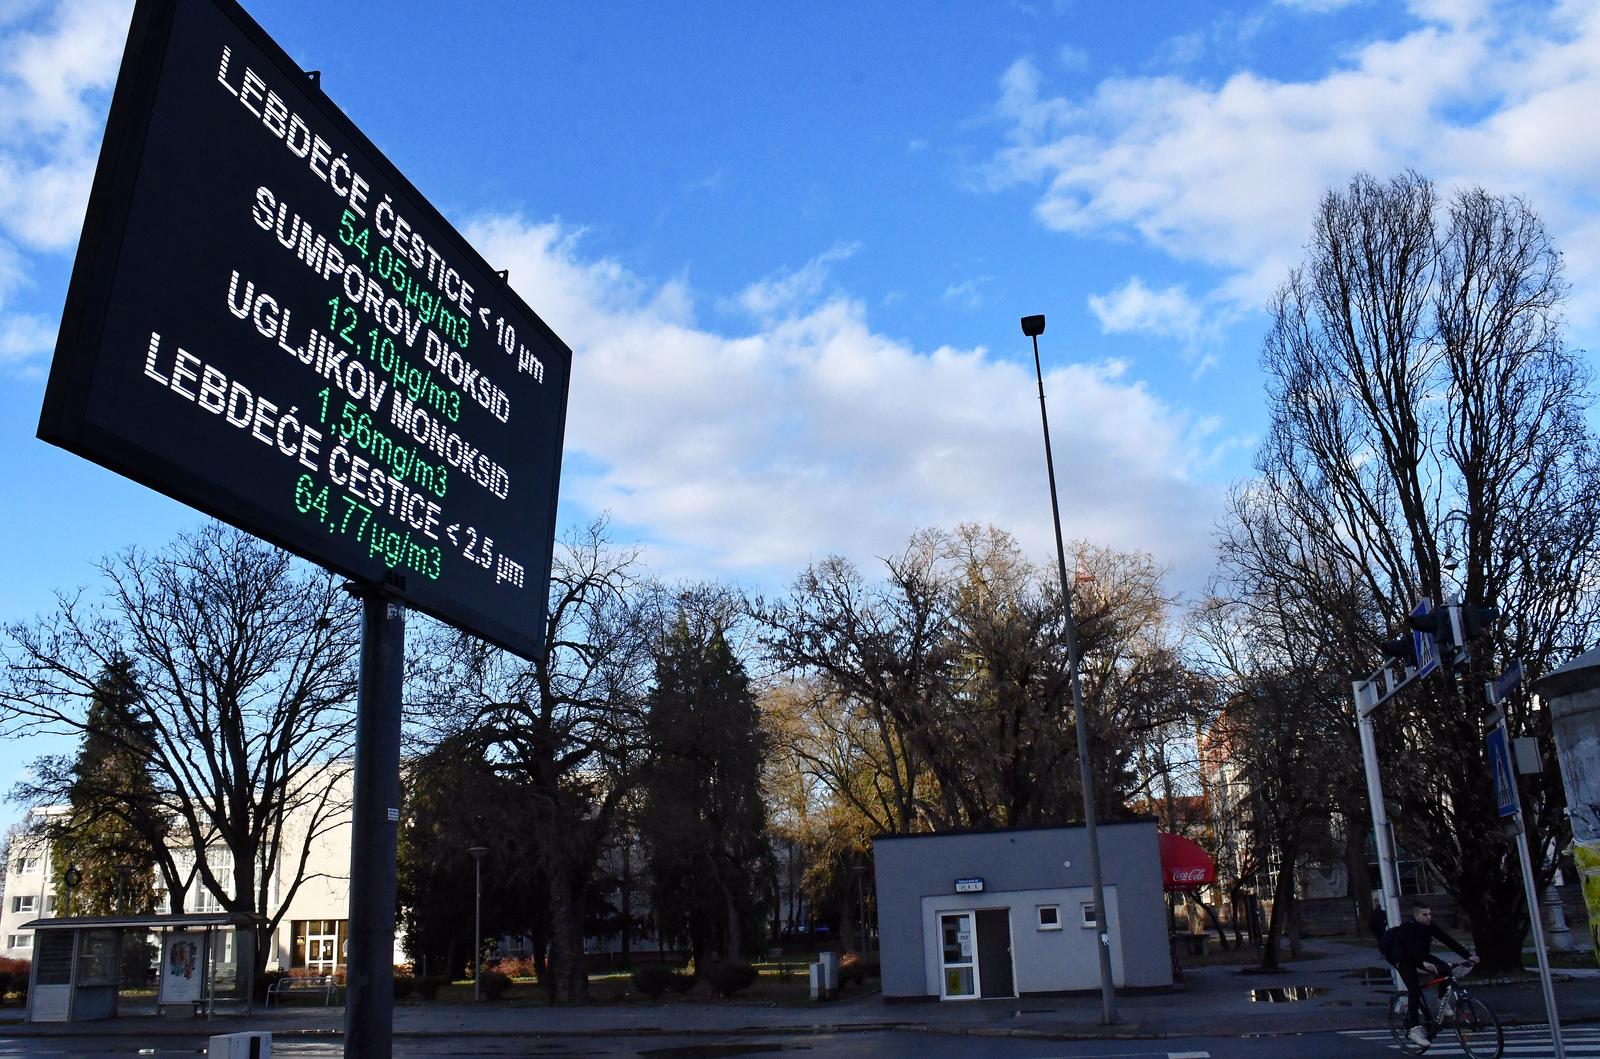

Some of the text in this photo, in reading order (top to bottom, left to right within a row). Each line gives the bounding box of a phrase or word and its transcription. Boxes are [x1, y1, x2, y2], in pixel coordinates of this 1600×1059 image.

[217, 44, 370, 219] LEBDEĆE
[375, 193, 475, 317] ČESTICE
[496, 316, 515, 355] 10
[252, 186, 510, 424] SUMPOROV DIOKSID
[144, 331, 323, 472] LEBDEĆE
[329, 434, 442, 541] ČESTICE
[227, 269, 510, 500] UGLJIKOV MONOKSID
